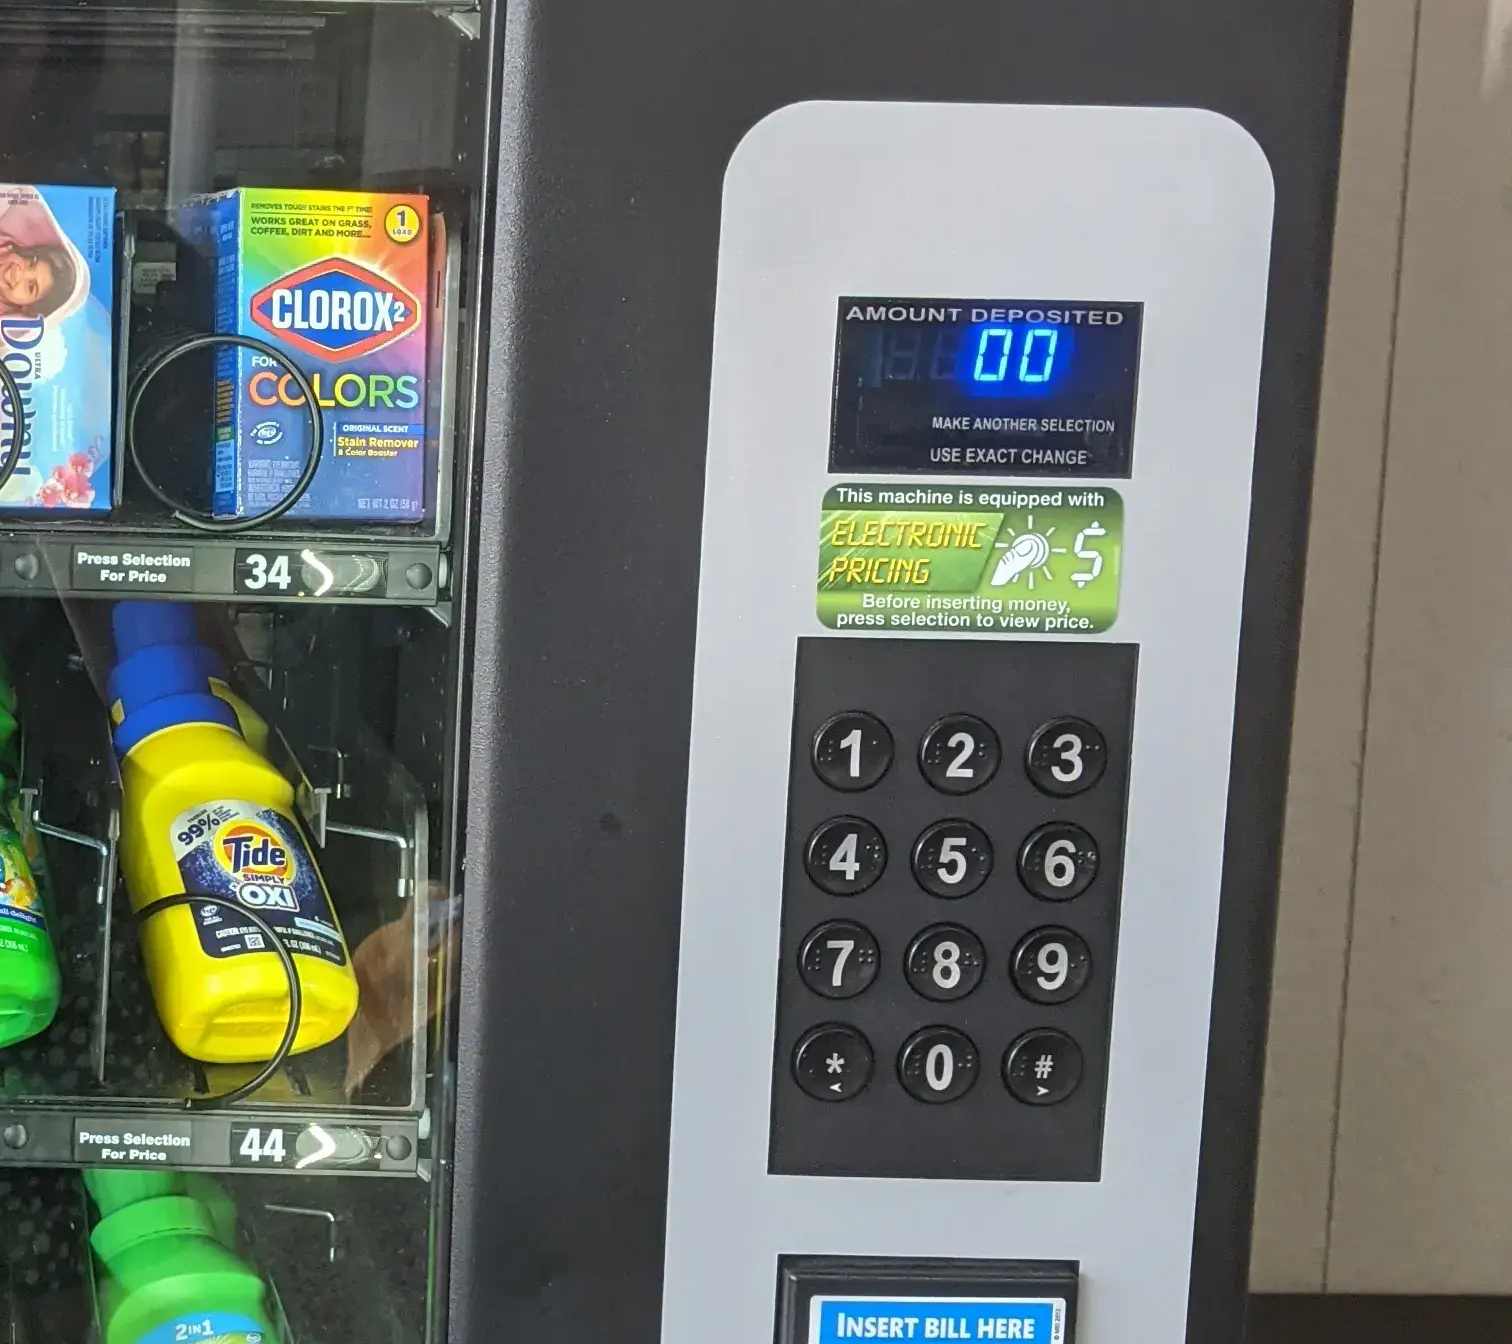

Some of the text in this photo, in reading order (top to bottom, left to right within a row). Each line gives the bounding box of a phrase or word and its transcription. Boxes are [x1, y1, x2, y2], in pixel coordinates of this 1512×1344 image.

[251, 216, 372, 229] WORKS GREAT ON GRASS,
[251, 226, 289, 236] COFFEE,
[292, 228, 312, 236] DIRT
[314, 229, 334, 237] AND
[271, 288, 394, 332] CLOROX
[846, 306, 1124, 325] AMOUNT DEPOSITED
[973, 328, 1058, 382] 00
[249, 372, 418, 408] COLORS
[343, 424, 409, 433] ORIGINAL SCENT
[932, 417, 1115, 432] MAKE ANOTHER SELECTION
[337, 436, 418, 449] Stain Remover
[930, 448, 1088, 465] USE EXACT CHANGE
[837, 488, 1105, 509] This machine is equipped with
[831, 519, 987, 548] ELECTRONIC
[77, 553, 190, 568] Press Selection
[244, 555, 290, 589] 34
[828, 556, 930, 584] PRICING
[100, 569, 166, 583] For Price
[862, 593, 1071, 615] Before inserting money,
[836, 611, 1094, 633] press selection to view price.
[840, 729, 861, 777] 1
[945, 732, 975, 778] 2
[1051, 734, 1083, 782] 3
[177, 814, 221, 846] 99%
[222, 835, 286, 874] Tide
[829, 833, 859, 880] 4
[937, 837, 967, 883] 5
[1044, 840, 1075, 887] 6
[243, 873, 285, 883] SIMPLY
[239, 885, 294, 909] OXI
[826, 940, 855, 987] 7
[932, 941, 961, 989] 8
[1036, 942, 1069, 990] 9
[926, 1043, 953, 1090] 0
[1035, 1055, 1054, 1079] #
[240, 1129, 285, 1162] 44
[837, 1312, 919, 1339] INSERT
[924, 1317, 971, 1340] BILL
[977, 1318, 1035, 1340] HERE
